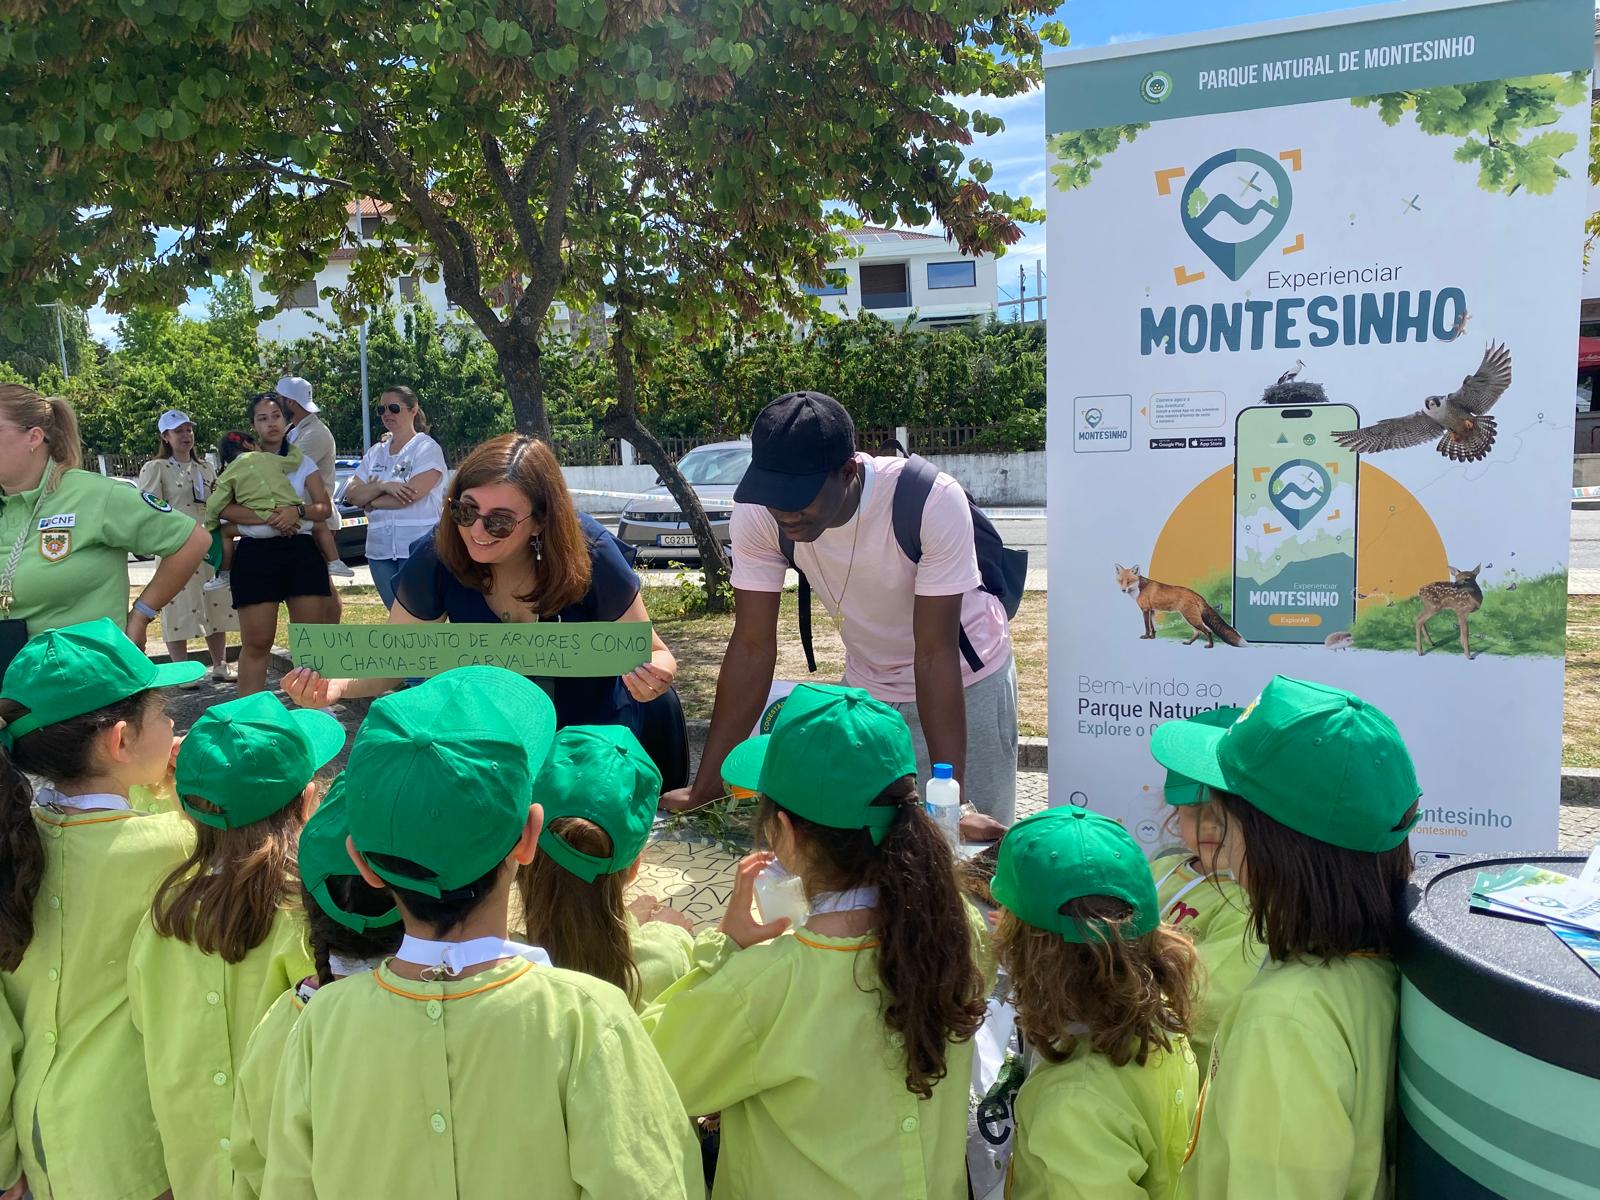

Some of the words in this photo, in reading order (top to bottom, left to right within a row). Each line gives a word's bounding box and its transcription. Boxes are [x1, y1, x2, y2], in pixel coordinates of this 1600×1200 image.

[1199, 65, 1258, 90] PARQUE
[1262, 55, 1334, 83] NATURAL
[1339, 50, 1360, 72] DE
[1364, 35, 1476, 69] MONTESINHO
[1268, 262, 1403, 291] Experienciar
[1140, 287, 1467, 356] MONTESINHO
[1078, 430, 1128, 441] MONTESINHO
[1293, 582, 1338, 591] Experienciar
[1249, 590, 1339, 607] MONTESINHO
[323, 631, 354, 649] UM
[368, 629, 460, 649] CONJUNTO
[470, 632, 489, 648] DE
[500, 632, 581, 651] ÁRVORES
[590, 632, 647, 653] COMO
[299, 654, 324, 671] EU
[340, 654, 439, 671] CHAMA-SE
[1078, 675, 1190, 697] Bem-vindo
[1195, 682, 1223, 698] ao
[1078, 698, 1143, 721] Parque
[1078, 720, 1132, 738] Explore
[1135, 726, 1145, 737] o
